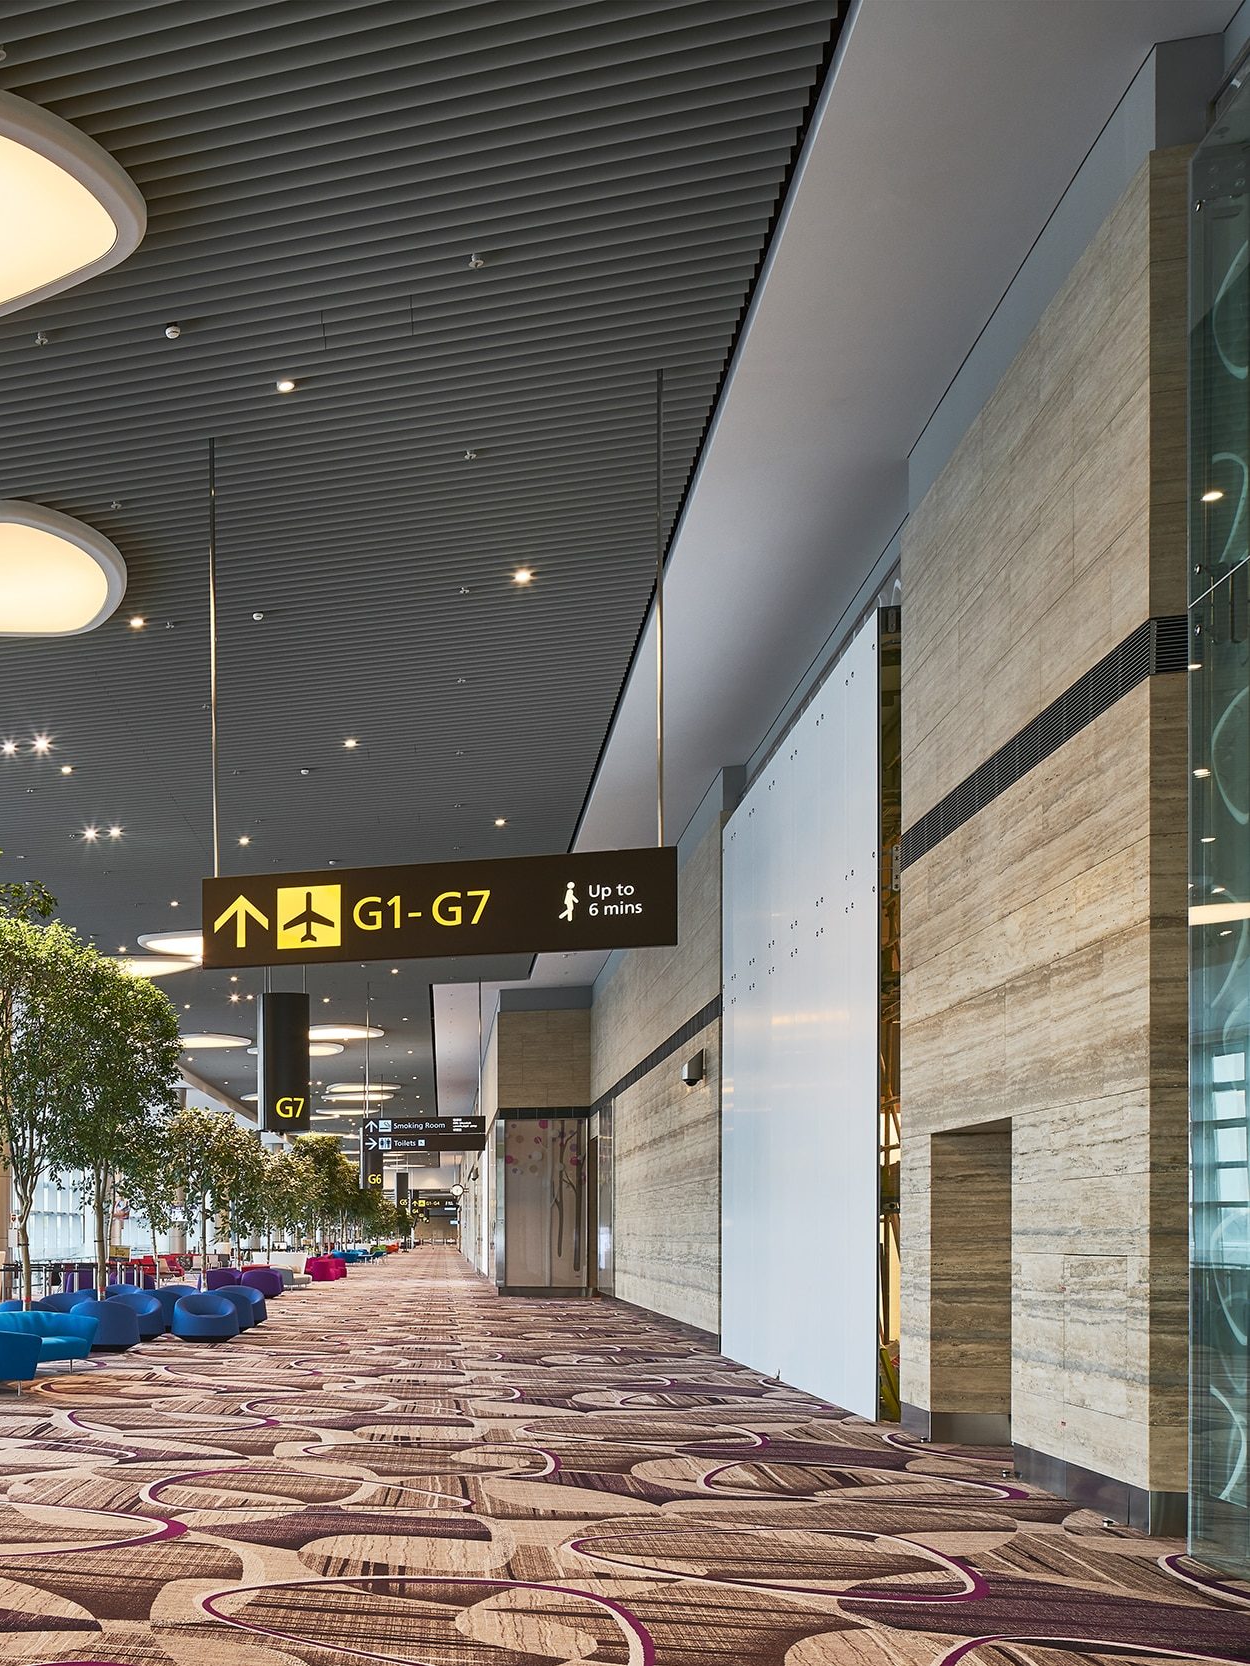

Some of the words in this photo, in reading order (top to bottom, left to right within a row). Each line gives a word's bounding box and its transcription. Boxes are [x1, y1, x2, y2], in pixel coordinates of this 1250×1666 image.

[588, 884, 612, 900] Up
[616, 882, 635, 896] to
[588, 902, 599, 916] 6
[603, 900, 643, 916] mins
[275, 1096, 305, 1118] G7
[393, 1121, 424, 1130] Smoking
[424, 1121, 446, 1129] Room
[367, 1174, 382, 1184] G6
